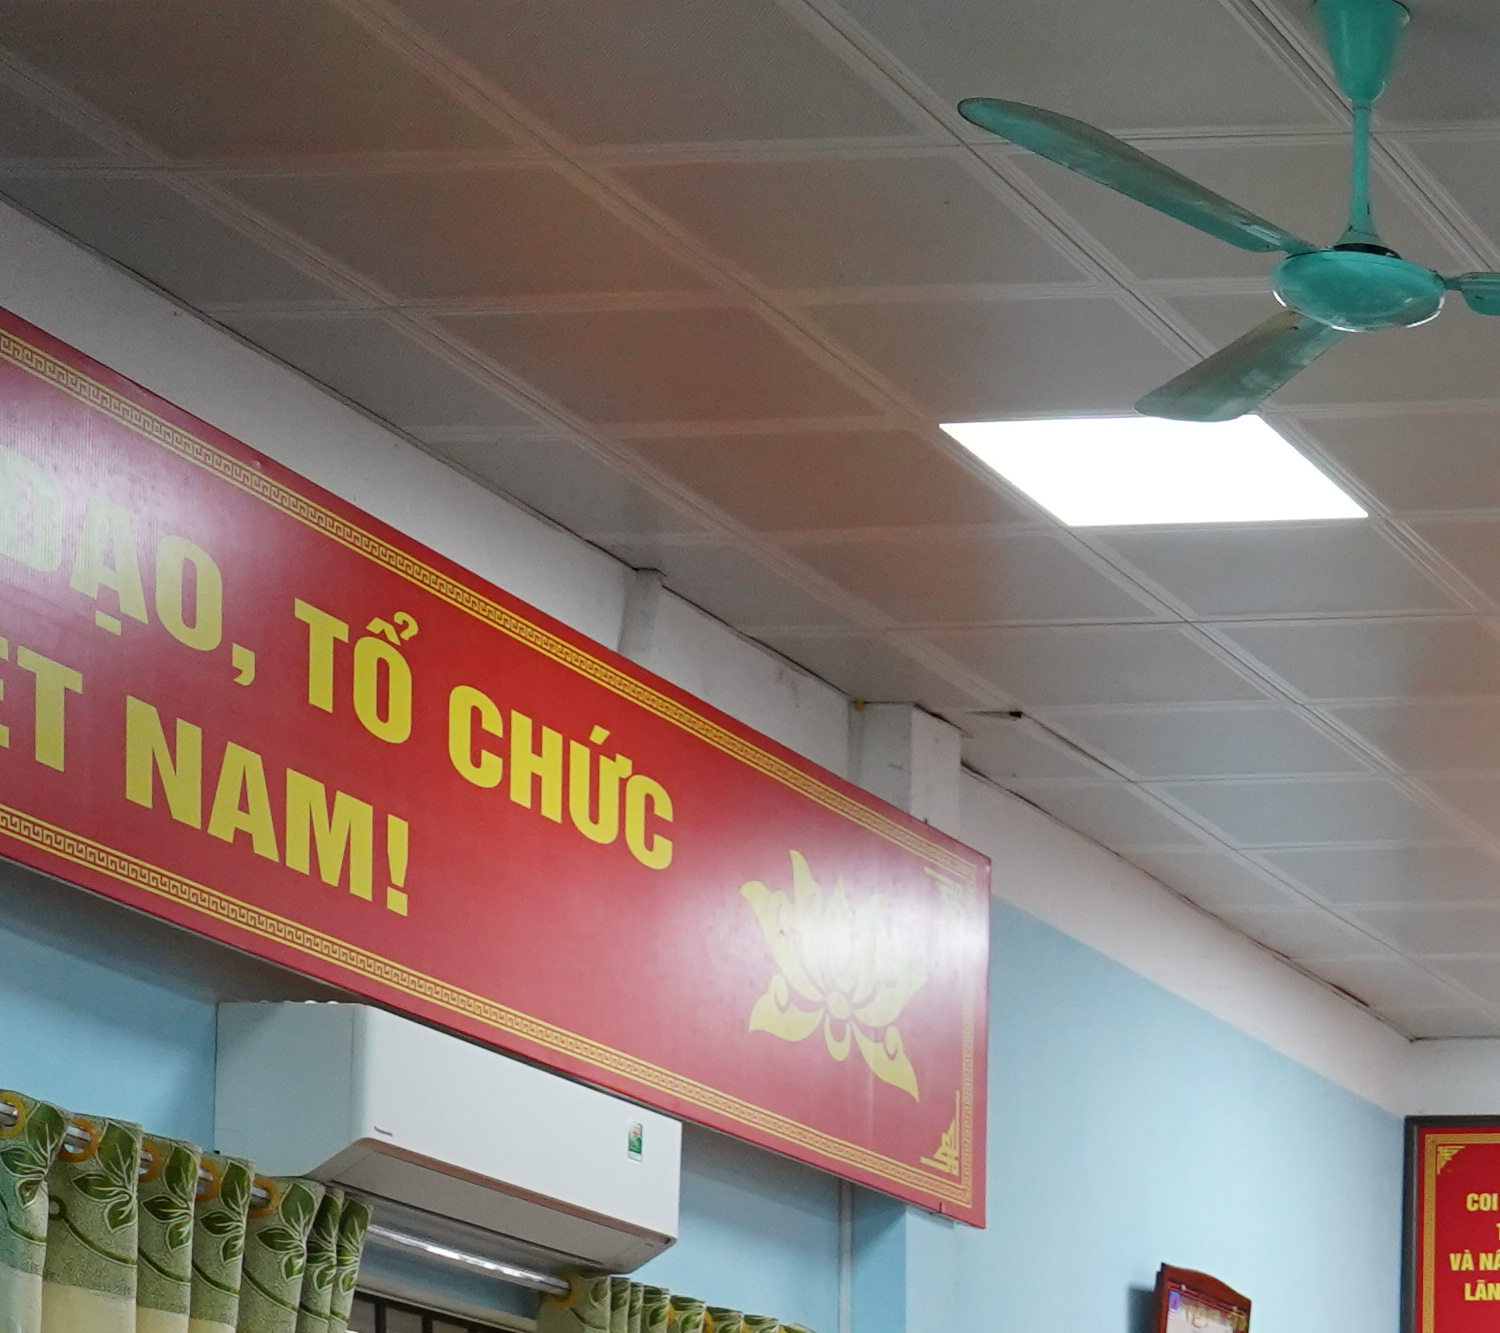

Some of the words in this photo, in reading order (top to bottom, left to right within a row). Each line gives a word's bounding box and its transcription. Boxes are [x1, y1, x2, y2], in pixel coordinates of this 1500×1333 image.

[125, 695, 408, 917] NAM!
[295, 598, 418, 743] TỔ
[449, 684, 674, 869] CHỨC
[1450, 1250, 1474, 1271] VÀ
